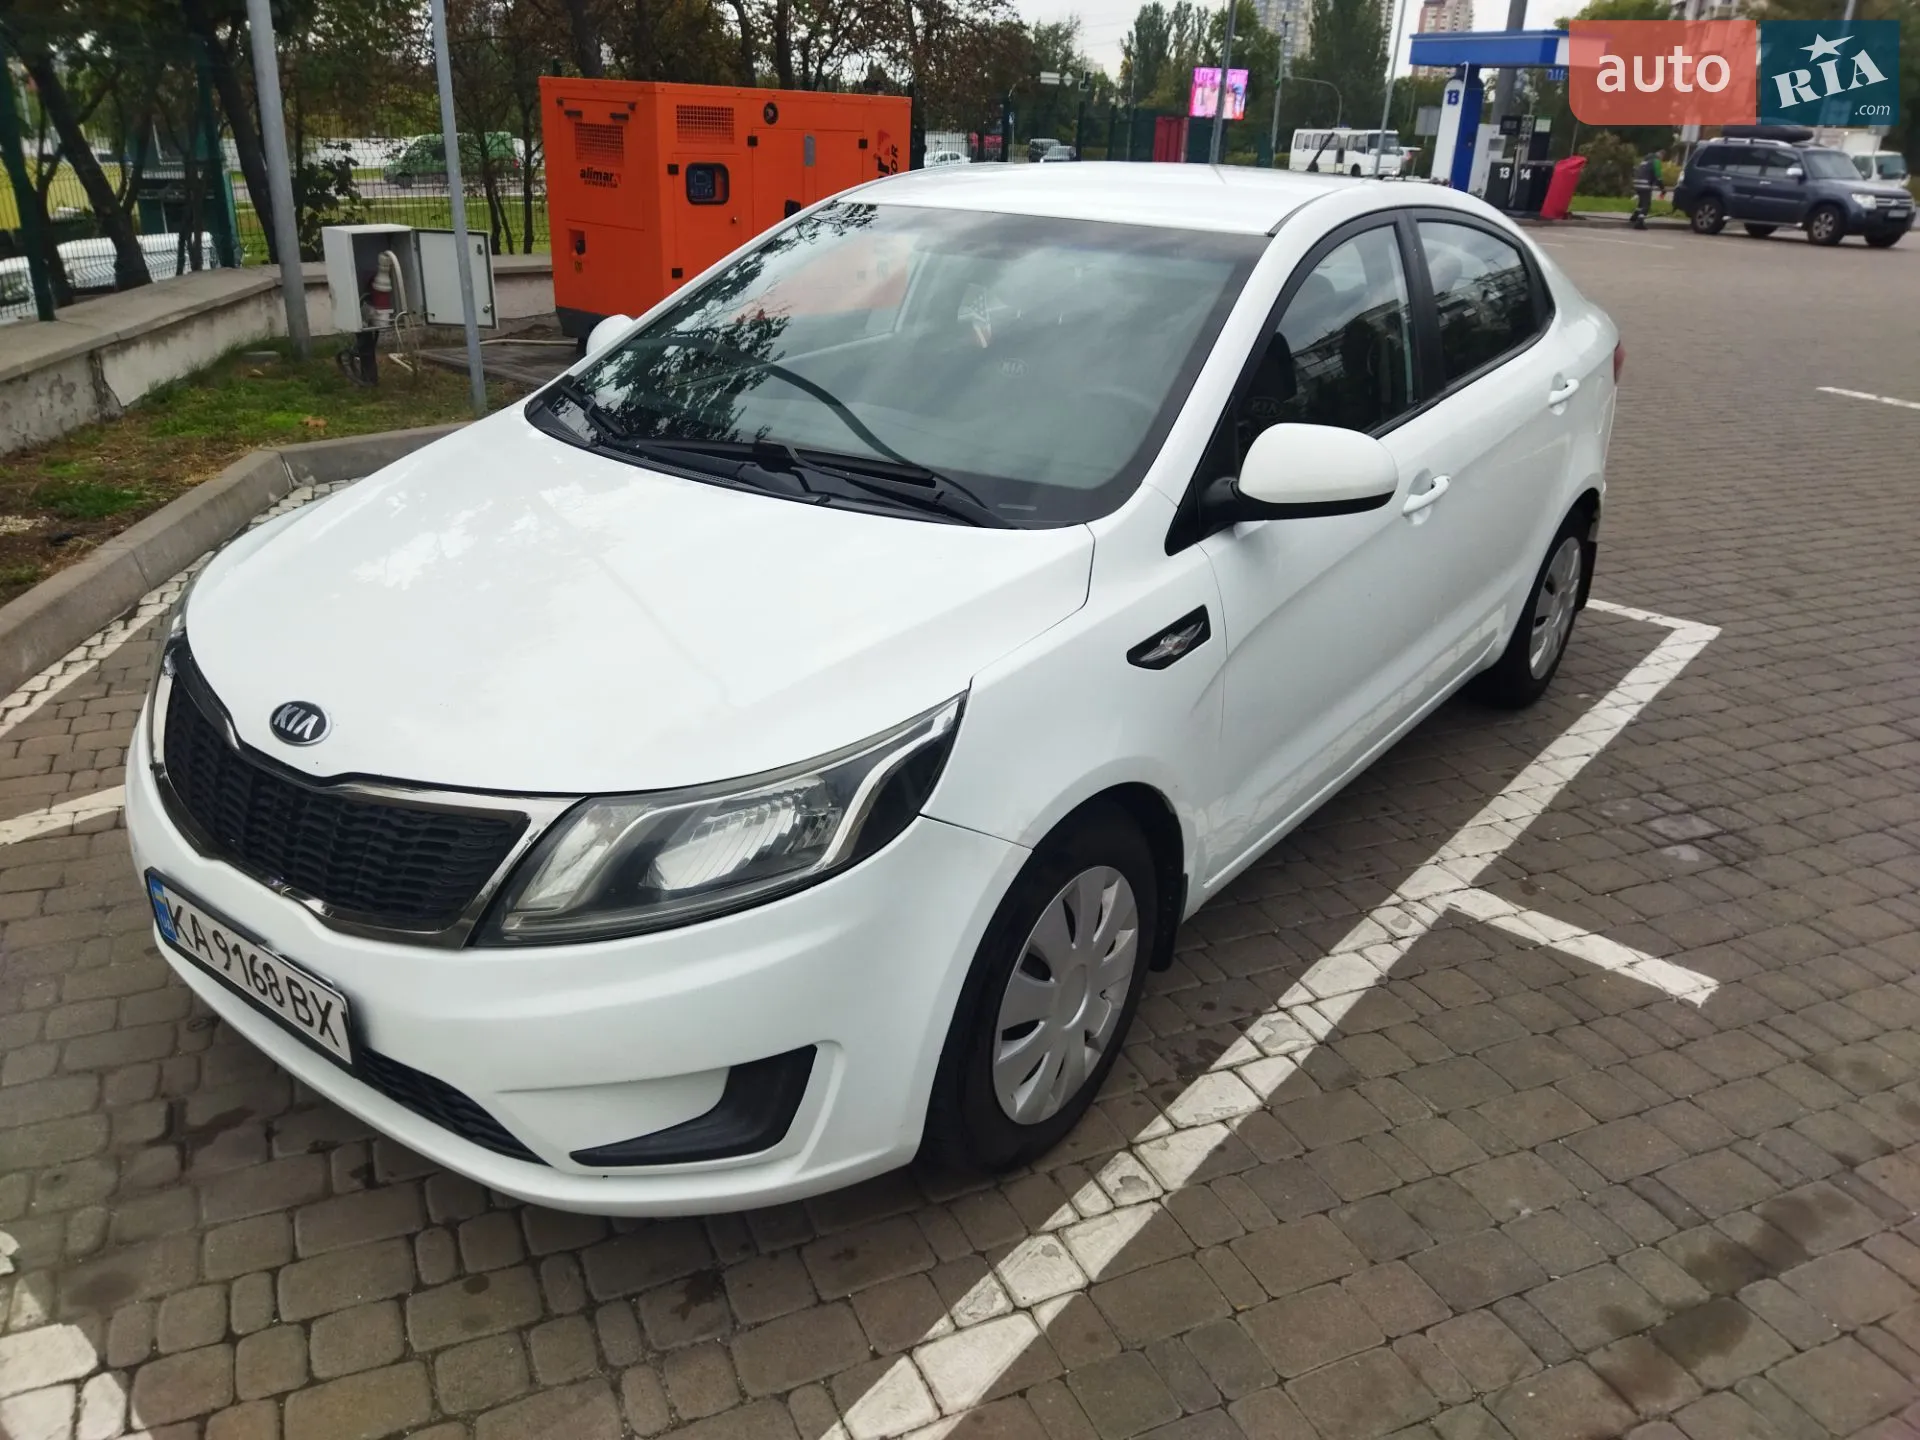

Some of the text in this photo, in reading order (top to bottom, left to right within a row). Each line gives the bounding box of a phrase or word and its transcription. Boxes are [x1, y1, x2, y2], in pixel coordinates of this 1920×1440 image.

[579, 166, 614, 182] alimar
[1499, 166, 1510, 179] 13
[1520, 168, 1531, 181] 14
[273, 703, 319, 740] KIA
